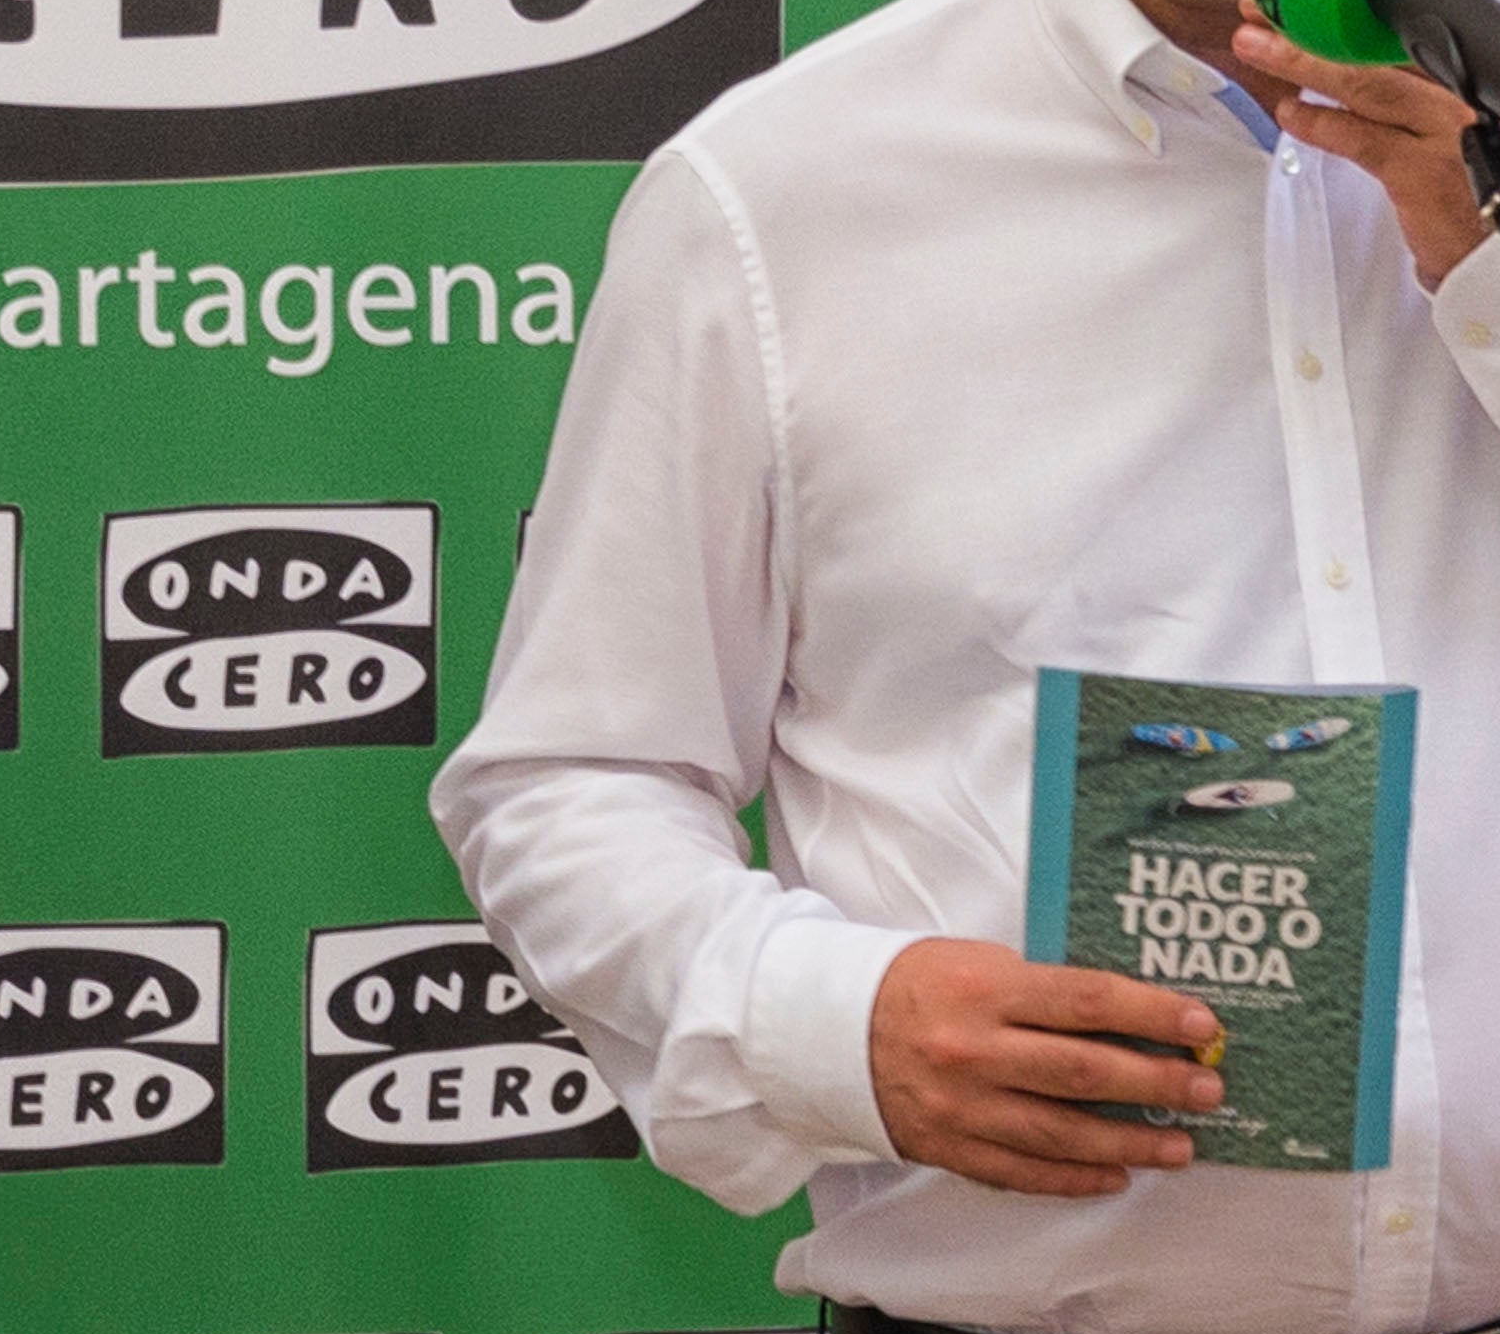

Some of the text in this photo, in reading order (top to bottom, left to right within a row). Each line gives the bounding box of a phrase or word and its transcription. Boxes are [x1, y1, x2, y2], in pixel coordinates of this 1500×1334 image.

[149, 558, 384, 609] ONDA
[165, 654, 383, 708] CERO
[1129, 852, 1310, 909] HACER
[1114, 893, 1323, 951] TODO O
[1139, 937, 1296, 990] NADA
[354, 971, 530, 1025] OND
[370, 1067, 587, 1123] CERO
